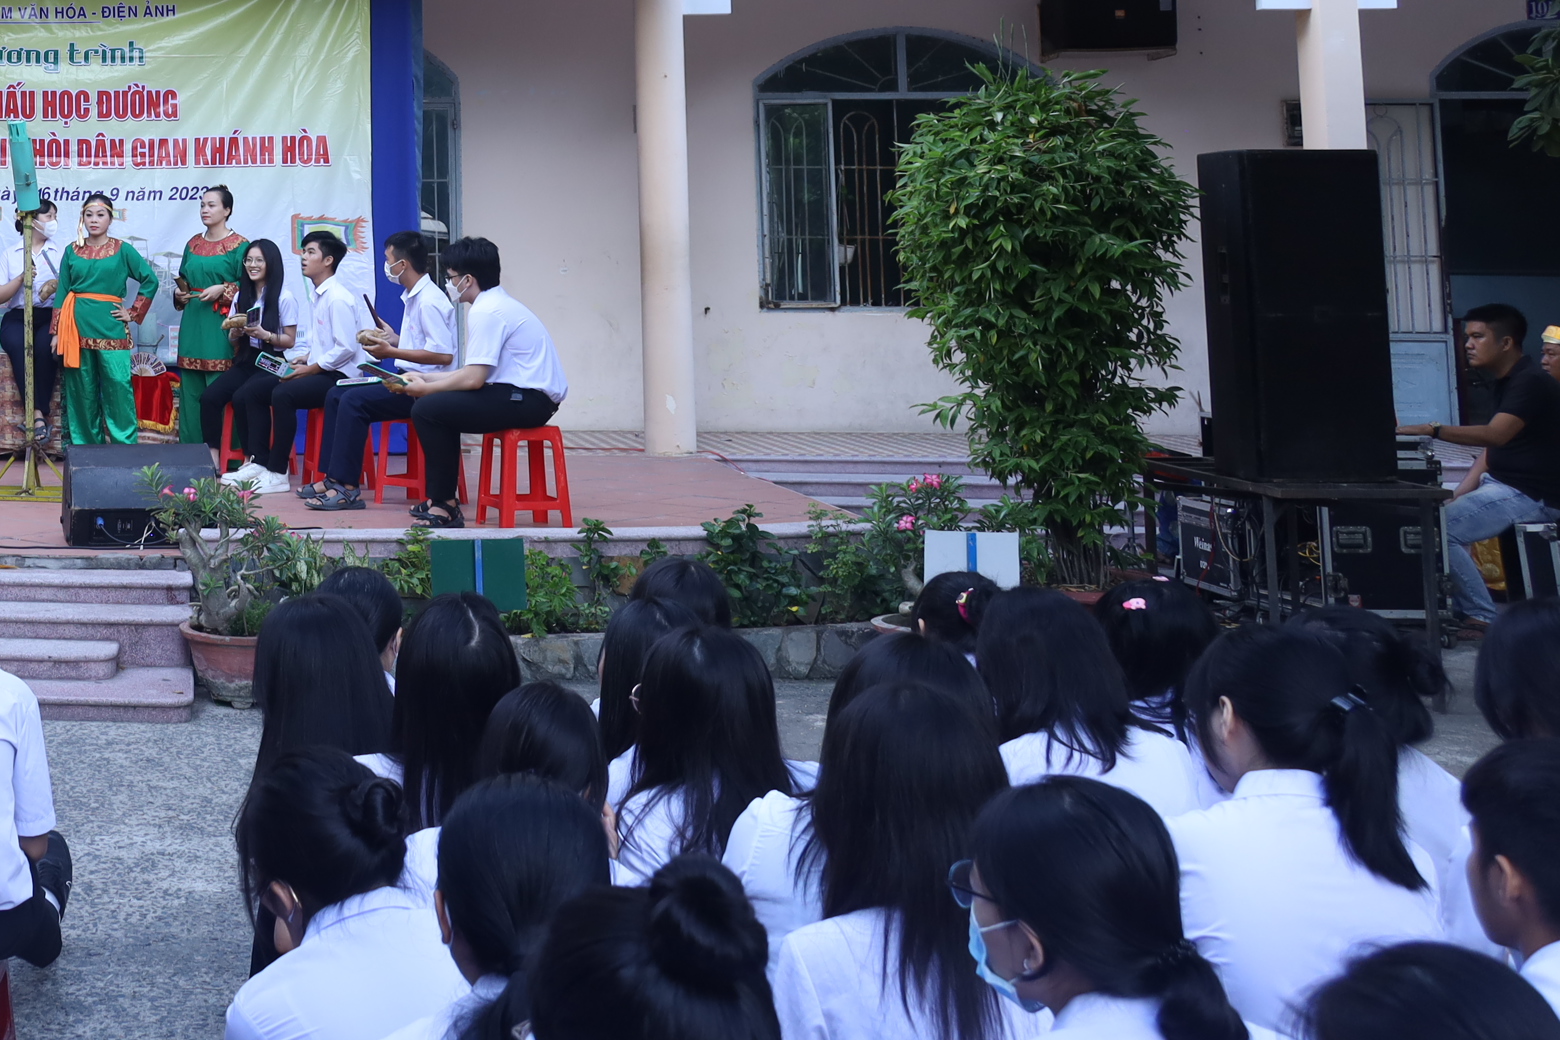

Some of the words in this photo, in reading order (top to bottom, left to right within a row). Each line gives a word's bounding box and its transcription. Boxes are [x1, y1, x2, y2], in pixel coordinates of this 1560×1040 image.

[18, 3, 48, 19] VĂN
[54, 3, 87, 19] HÓA
[101, 2, 138, 21] ĐIỆN
[143, 0, 176, 18] ẢNH
[67, 40, 146, 66] trình
[41, 89, 91, 127] HỌC
[96, 82, 179, 121] ĐƯỜNG
[32, 131, 72, 169] HÒI
[76, 132, 125, 169] DÂN
[131, 137, 188, 169] GIAN
[194, 130, 276, 168] KHÁNH
[281, 128, 332, 167] HÒA
[110, 187, 120, 201] 9
[125, 187, 163, 201] năm
